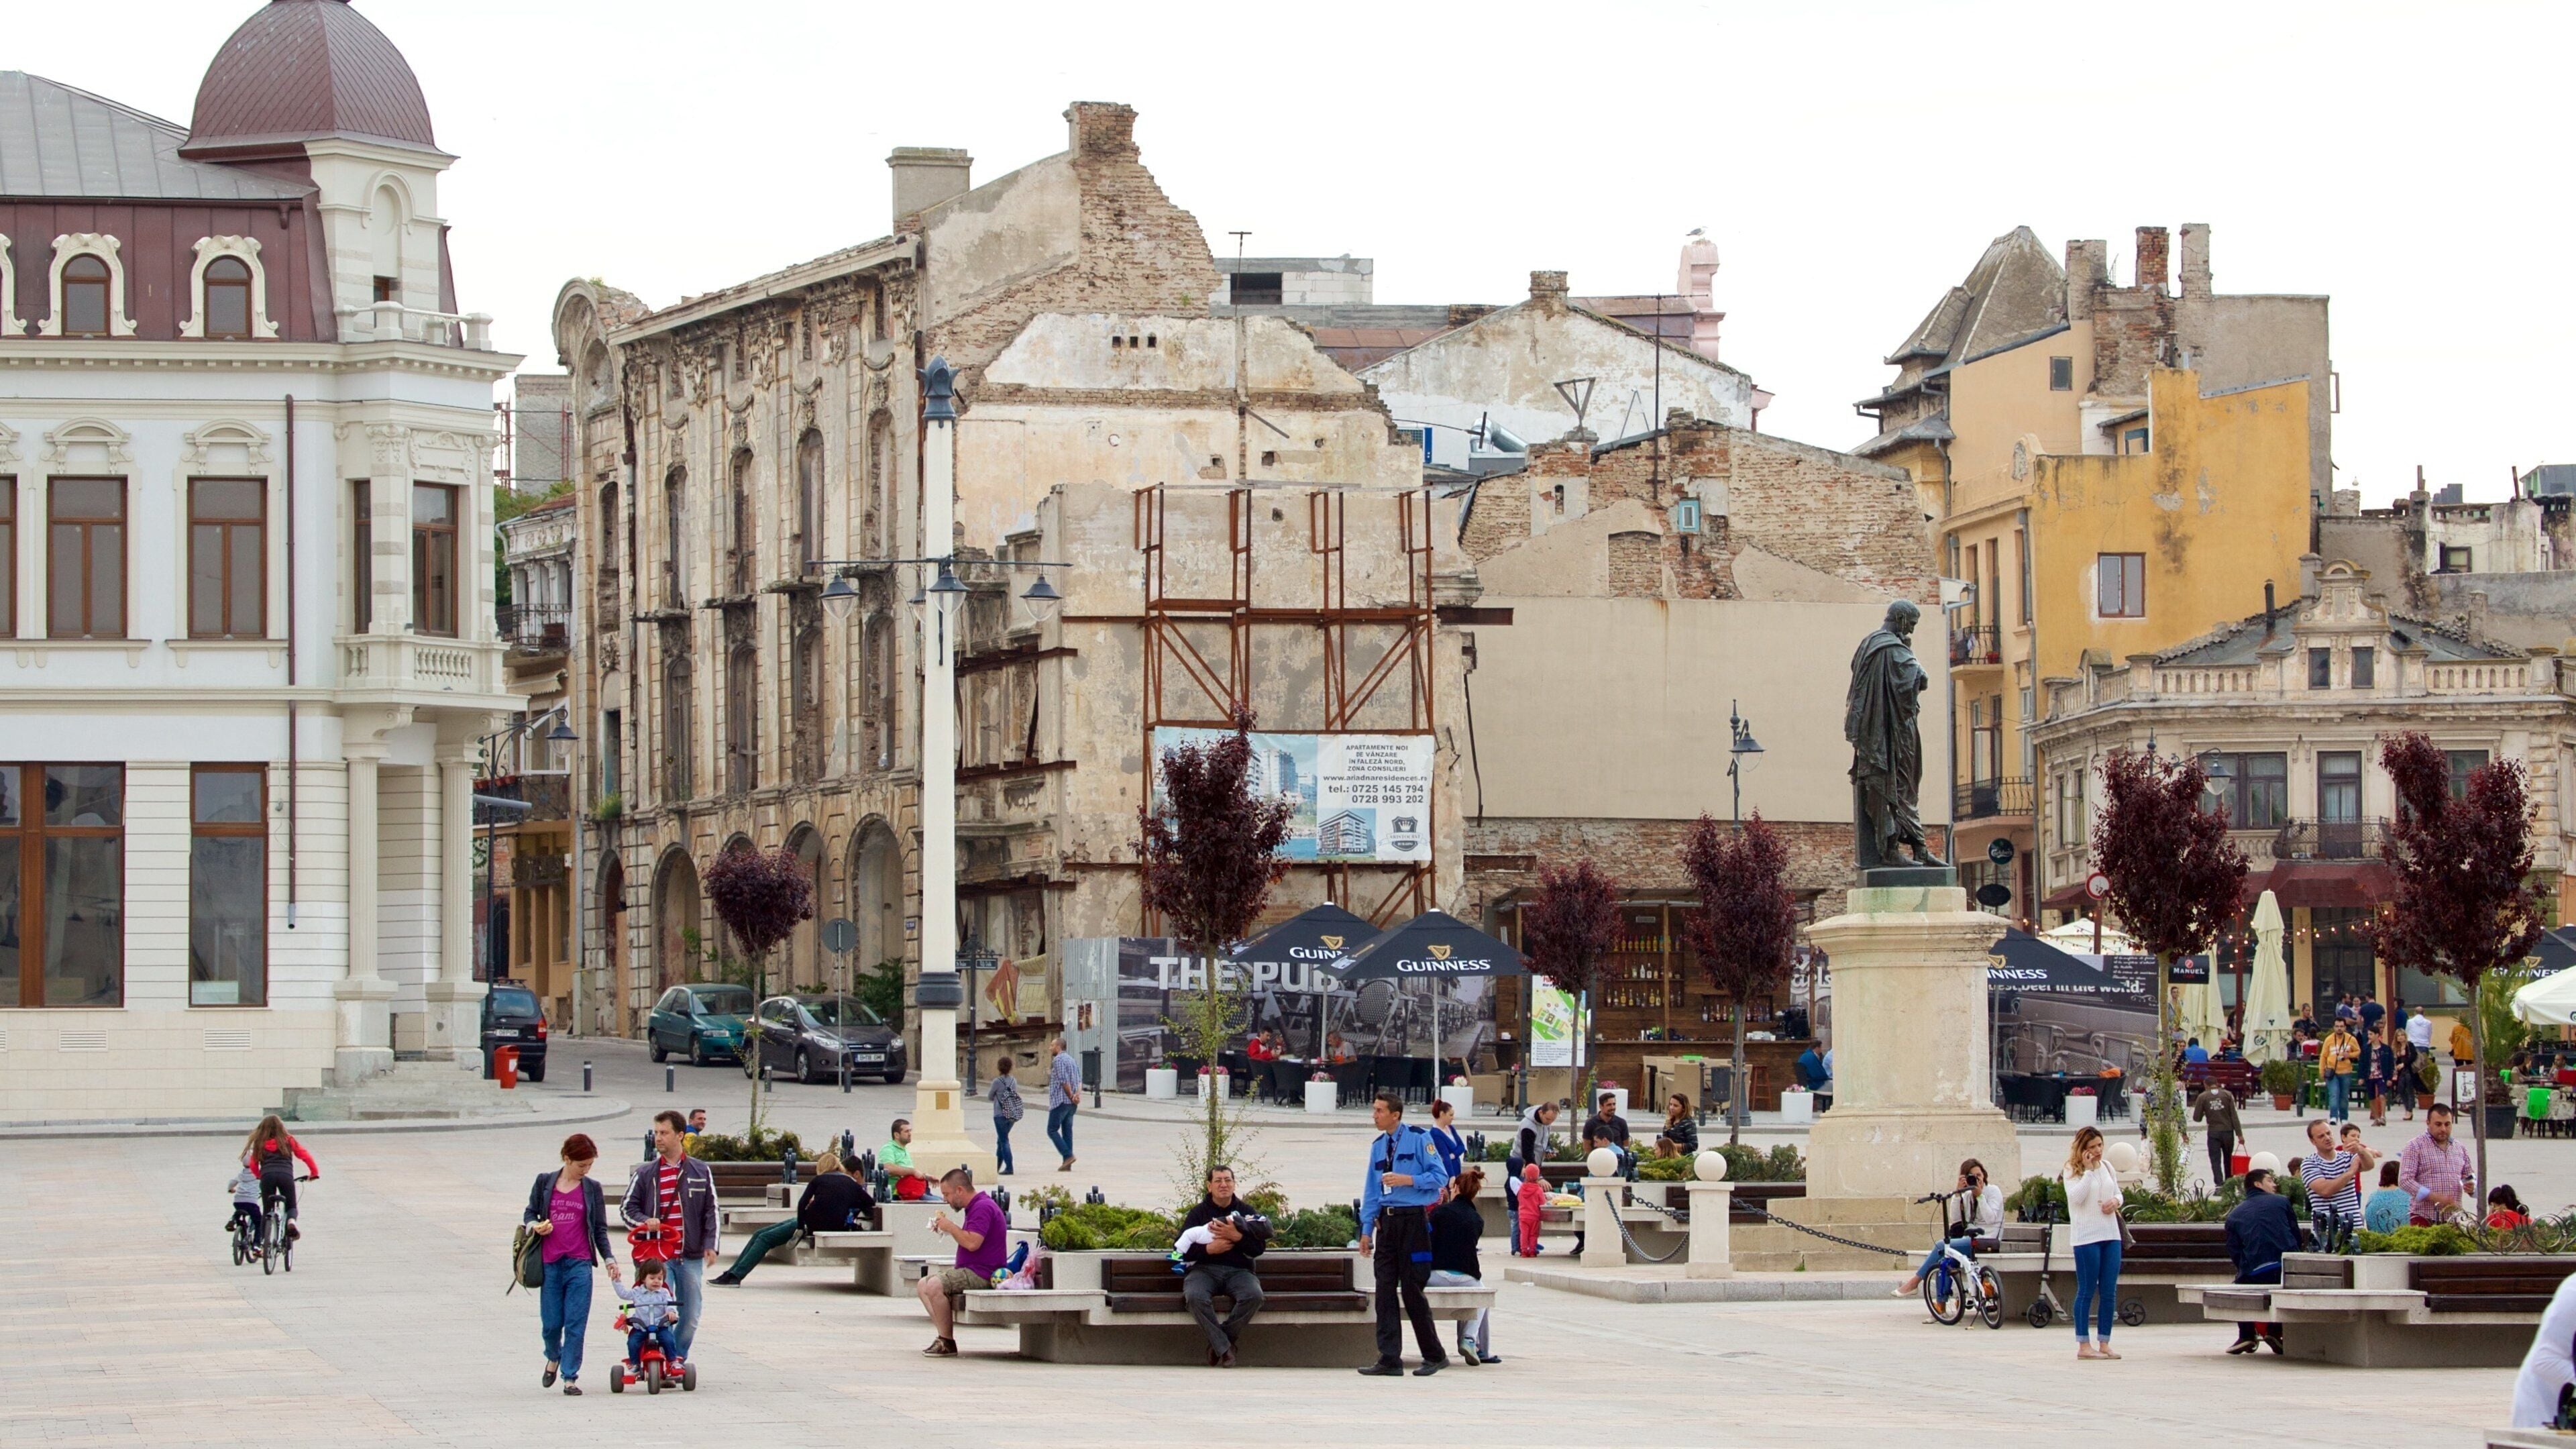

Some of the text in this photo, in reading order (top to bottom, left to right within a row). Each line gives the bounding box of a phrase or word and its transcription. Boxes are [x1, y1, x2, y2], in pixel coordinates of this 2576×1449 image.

[1328, 785, 1424, 793] tel.: 0725 145 794
[1352, 795, 1424, 804] 0728 993 202
[1396, 959, 1490, 972] GUINNESS
[1149, 957, 1238, 991] THE
[1987, 969, 2048, 979] INNESS
